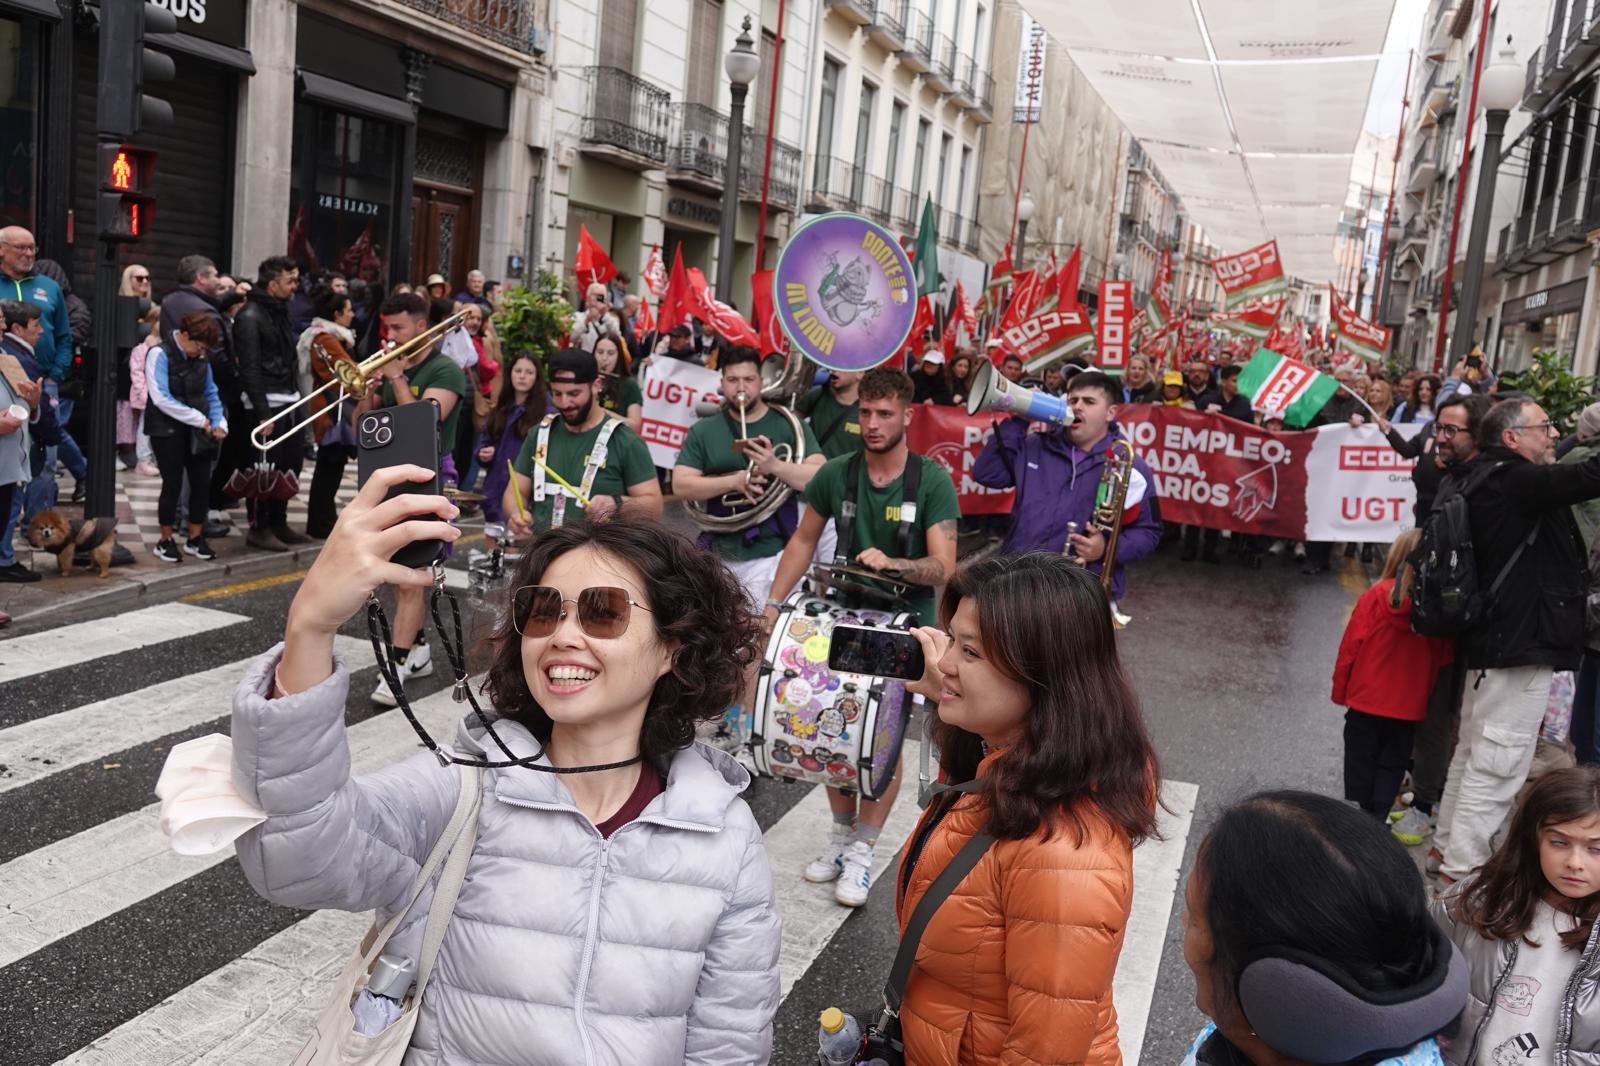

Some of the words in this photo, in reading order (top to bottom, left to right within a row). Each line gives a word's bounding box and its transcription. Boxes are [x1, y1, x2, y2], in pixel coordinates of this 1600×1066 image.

[862, 230, 904, 276] PONTE
[1102, 283, 1126, 365] CCOO
[646, 379, 697, 408] UGT
[641, 422, 687, 446] CCO
[1164, 424, 1292, 464] EMPLEO:
[1341, 496, 1407, 521] UGT
